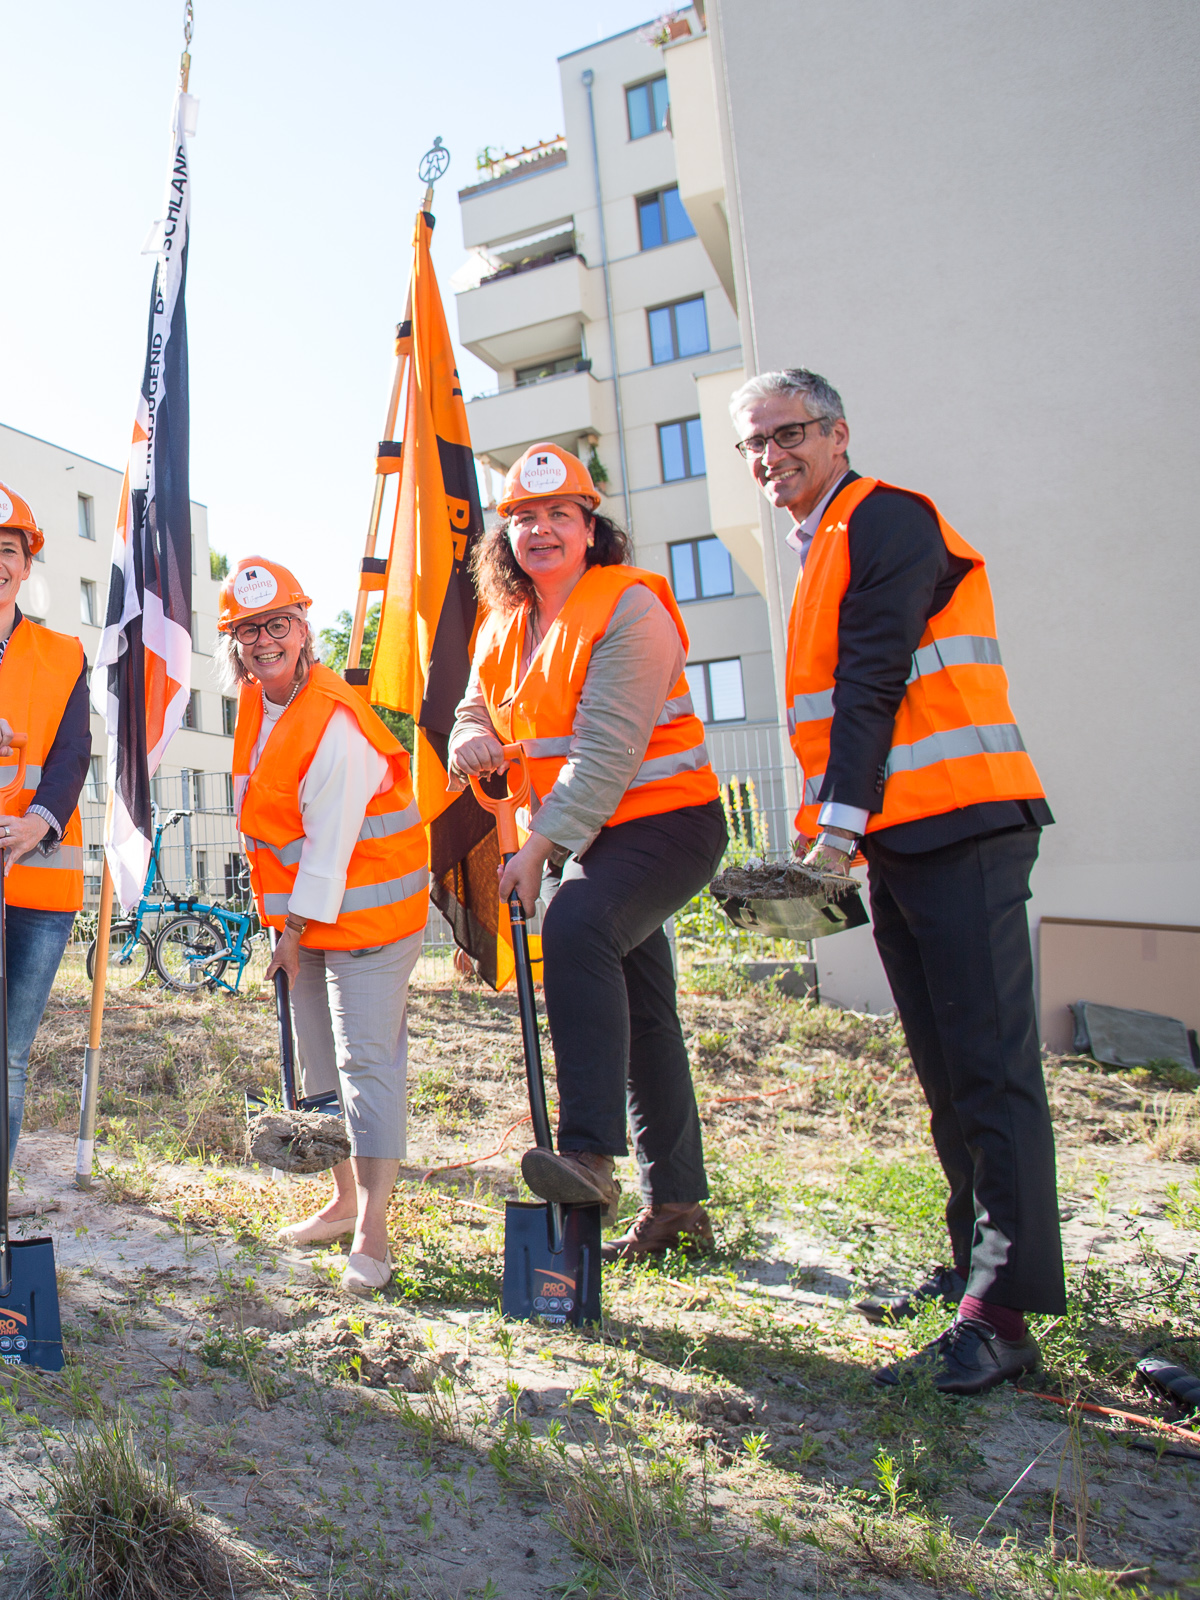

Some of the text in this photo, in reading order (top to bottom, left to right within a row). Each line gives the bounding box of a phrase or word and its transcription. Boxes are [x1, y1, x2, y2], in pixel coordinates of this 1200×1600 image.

[524, 466, 562, 478] Kolping
[237, 579, 273, 595] Kolping
[543, 1282, 567, 1293] PRO
